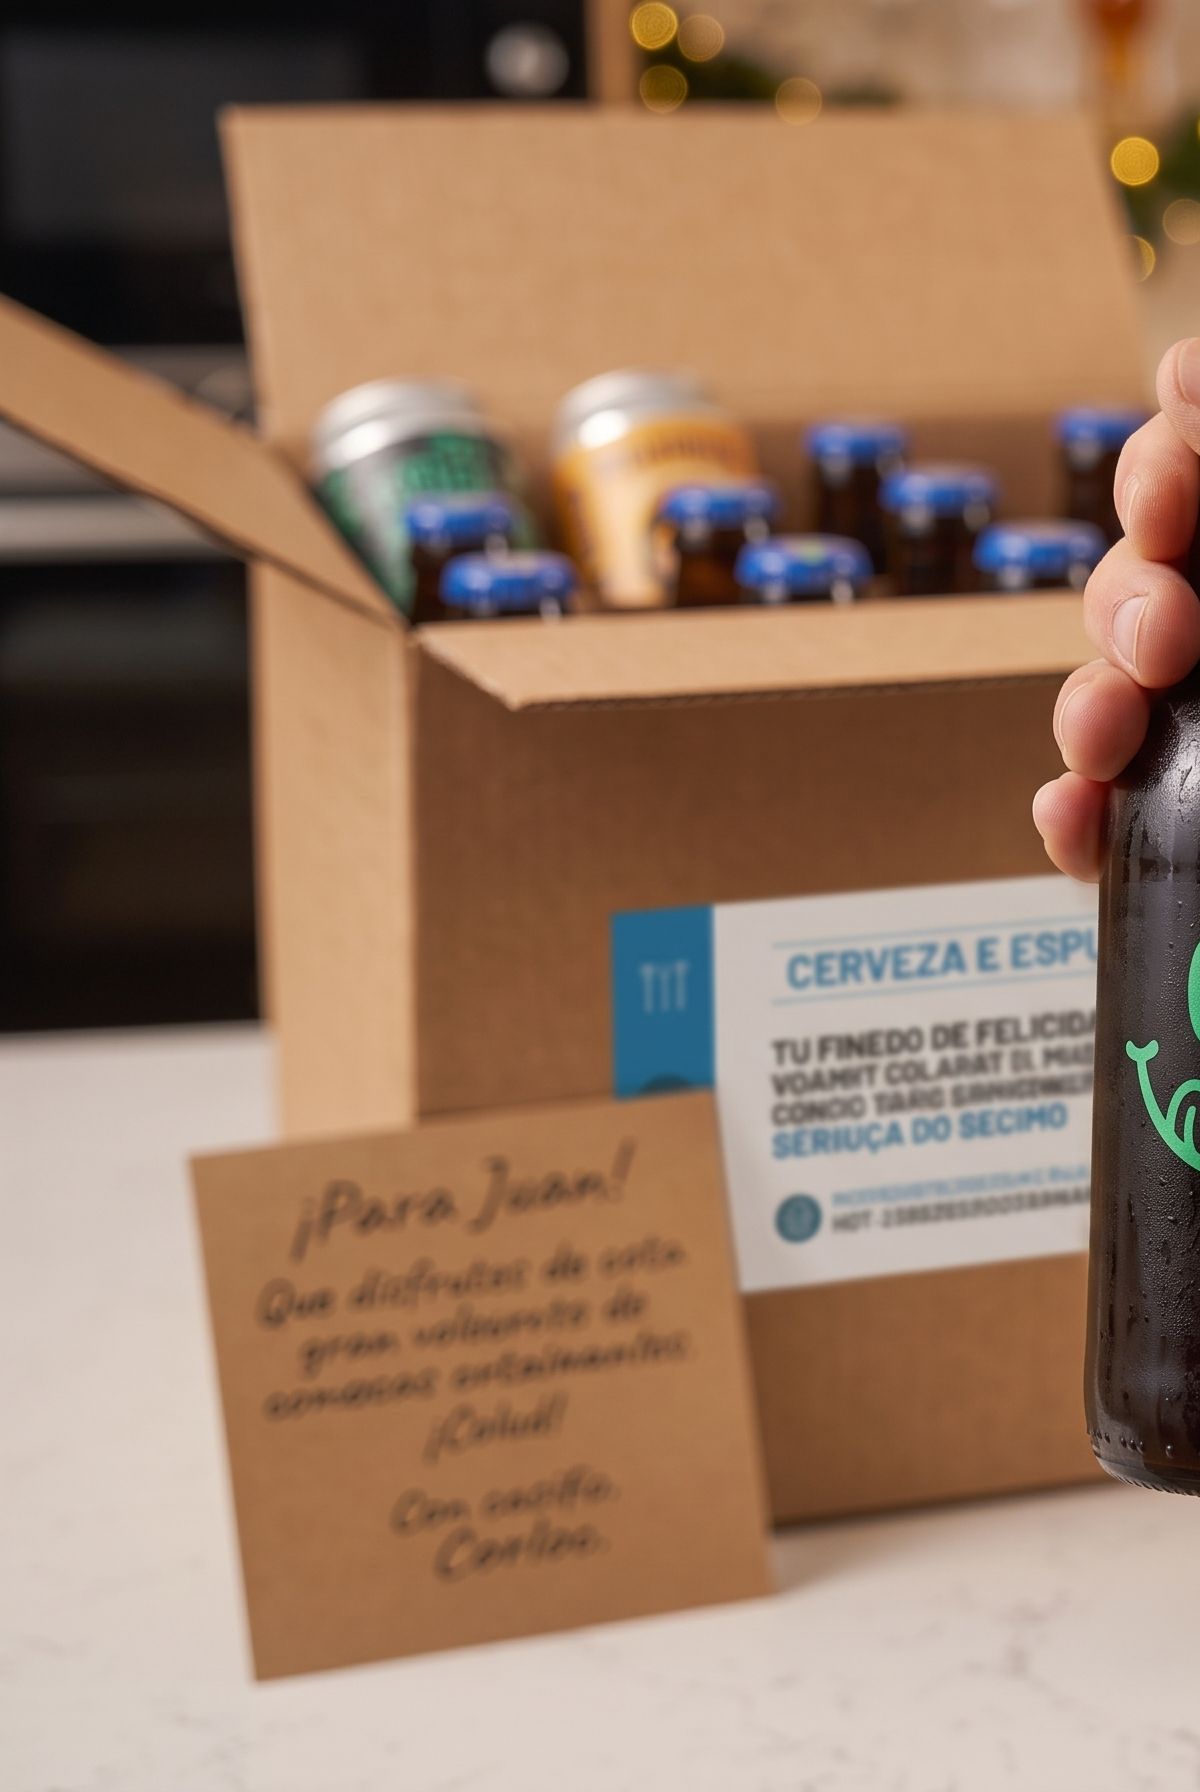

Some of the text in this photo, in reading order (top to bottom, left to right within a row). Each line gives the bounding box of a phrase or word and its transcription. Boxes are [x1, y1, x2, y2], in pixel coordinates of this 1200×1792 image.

[787, 940, 966, 990] CERVEZA
[977, 937, 1000, 972] E
[772, 1036, 810, 1066] TU
[818, 1027, 924, 1063] FINEDO
[931, 1021, 967, 1051] DE
[912, 1114, 951, 1145] DO
[959, 1102, 1068, 1140] SECIMO
[257, 1277, 334, 1331] Que
